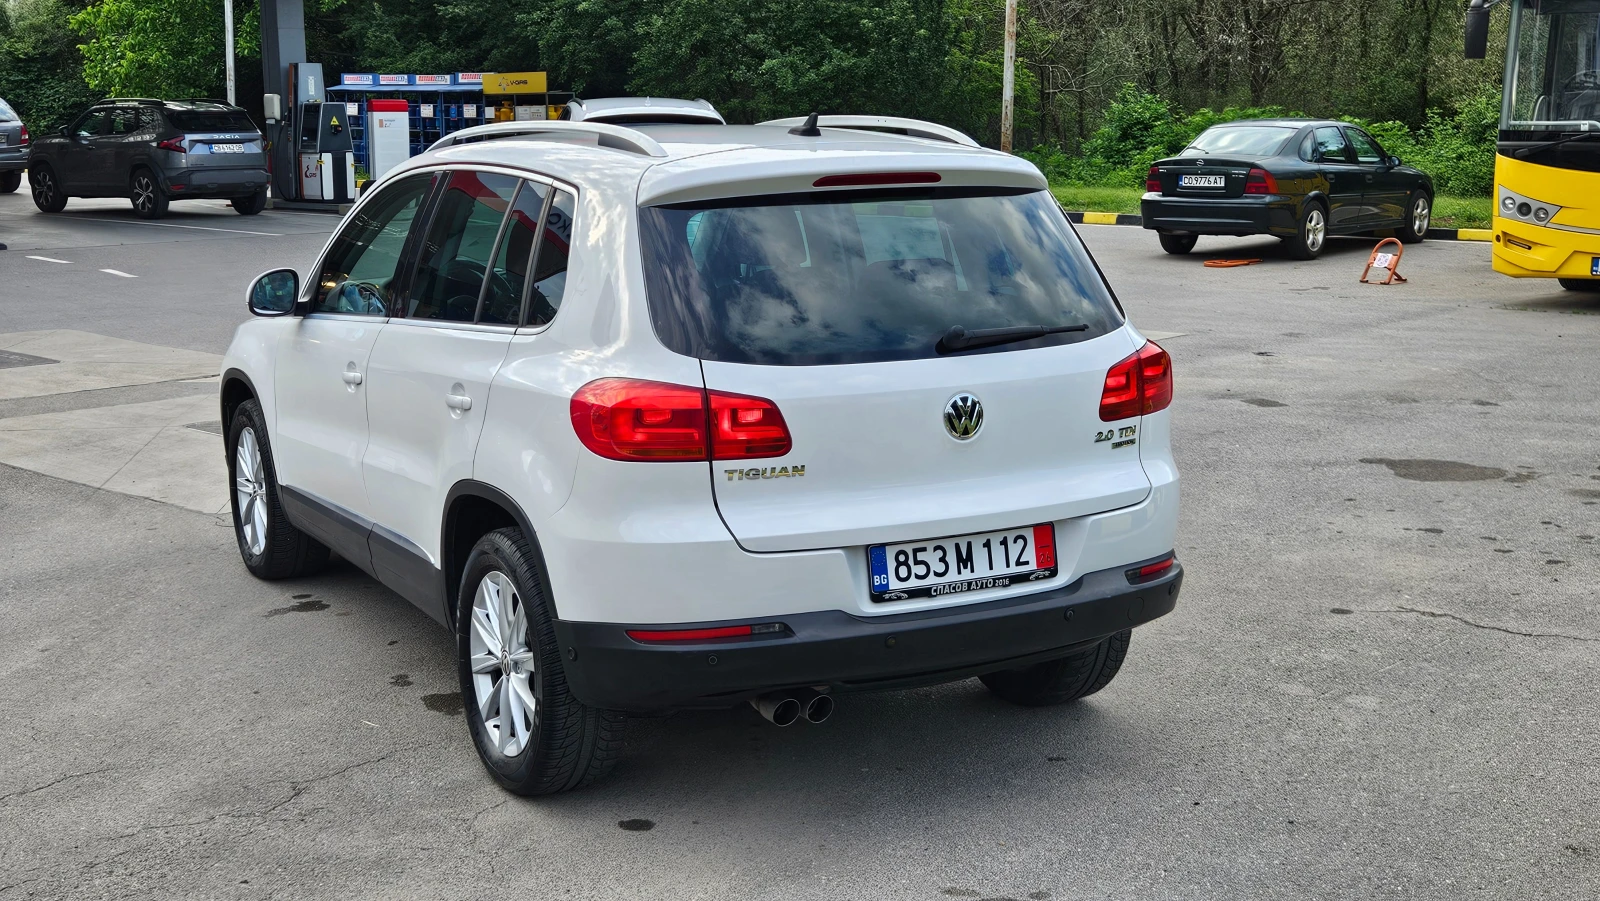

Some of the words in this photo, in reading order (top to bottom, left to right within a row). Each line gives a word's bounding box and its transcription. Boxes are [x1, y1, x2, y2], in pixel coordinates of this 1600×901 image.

[1194, 176, 1212, 185] 9776
[1213, 176, 1224, 185] AT
[1094, 429, 1115, 443] 2.0
[1118, 424, 1137, 438] TDI
[724, 464, 806, 481] TIGUAN
[894, 544, 950, 583] 853
[954, 540, 975, 575] M
[982, 534, 1030, 571] 112
[873, 574, 888, 586] BG
[931, 582, 968, 596] СПАСОВ
[970, 578, 994, 590] АУТО
[995, 577, 1010, 587] 2016
